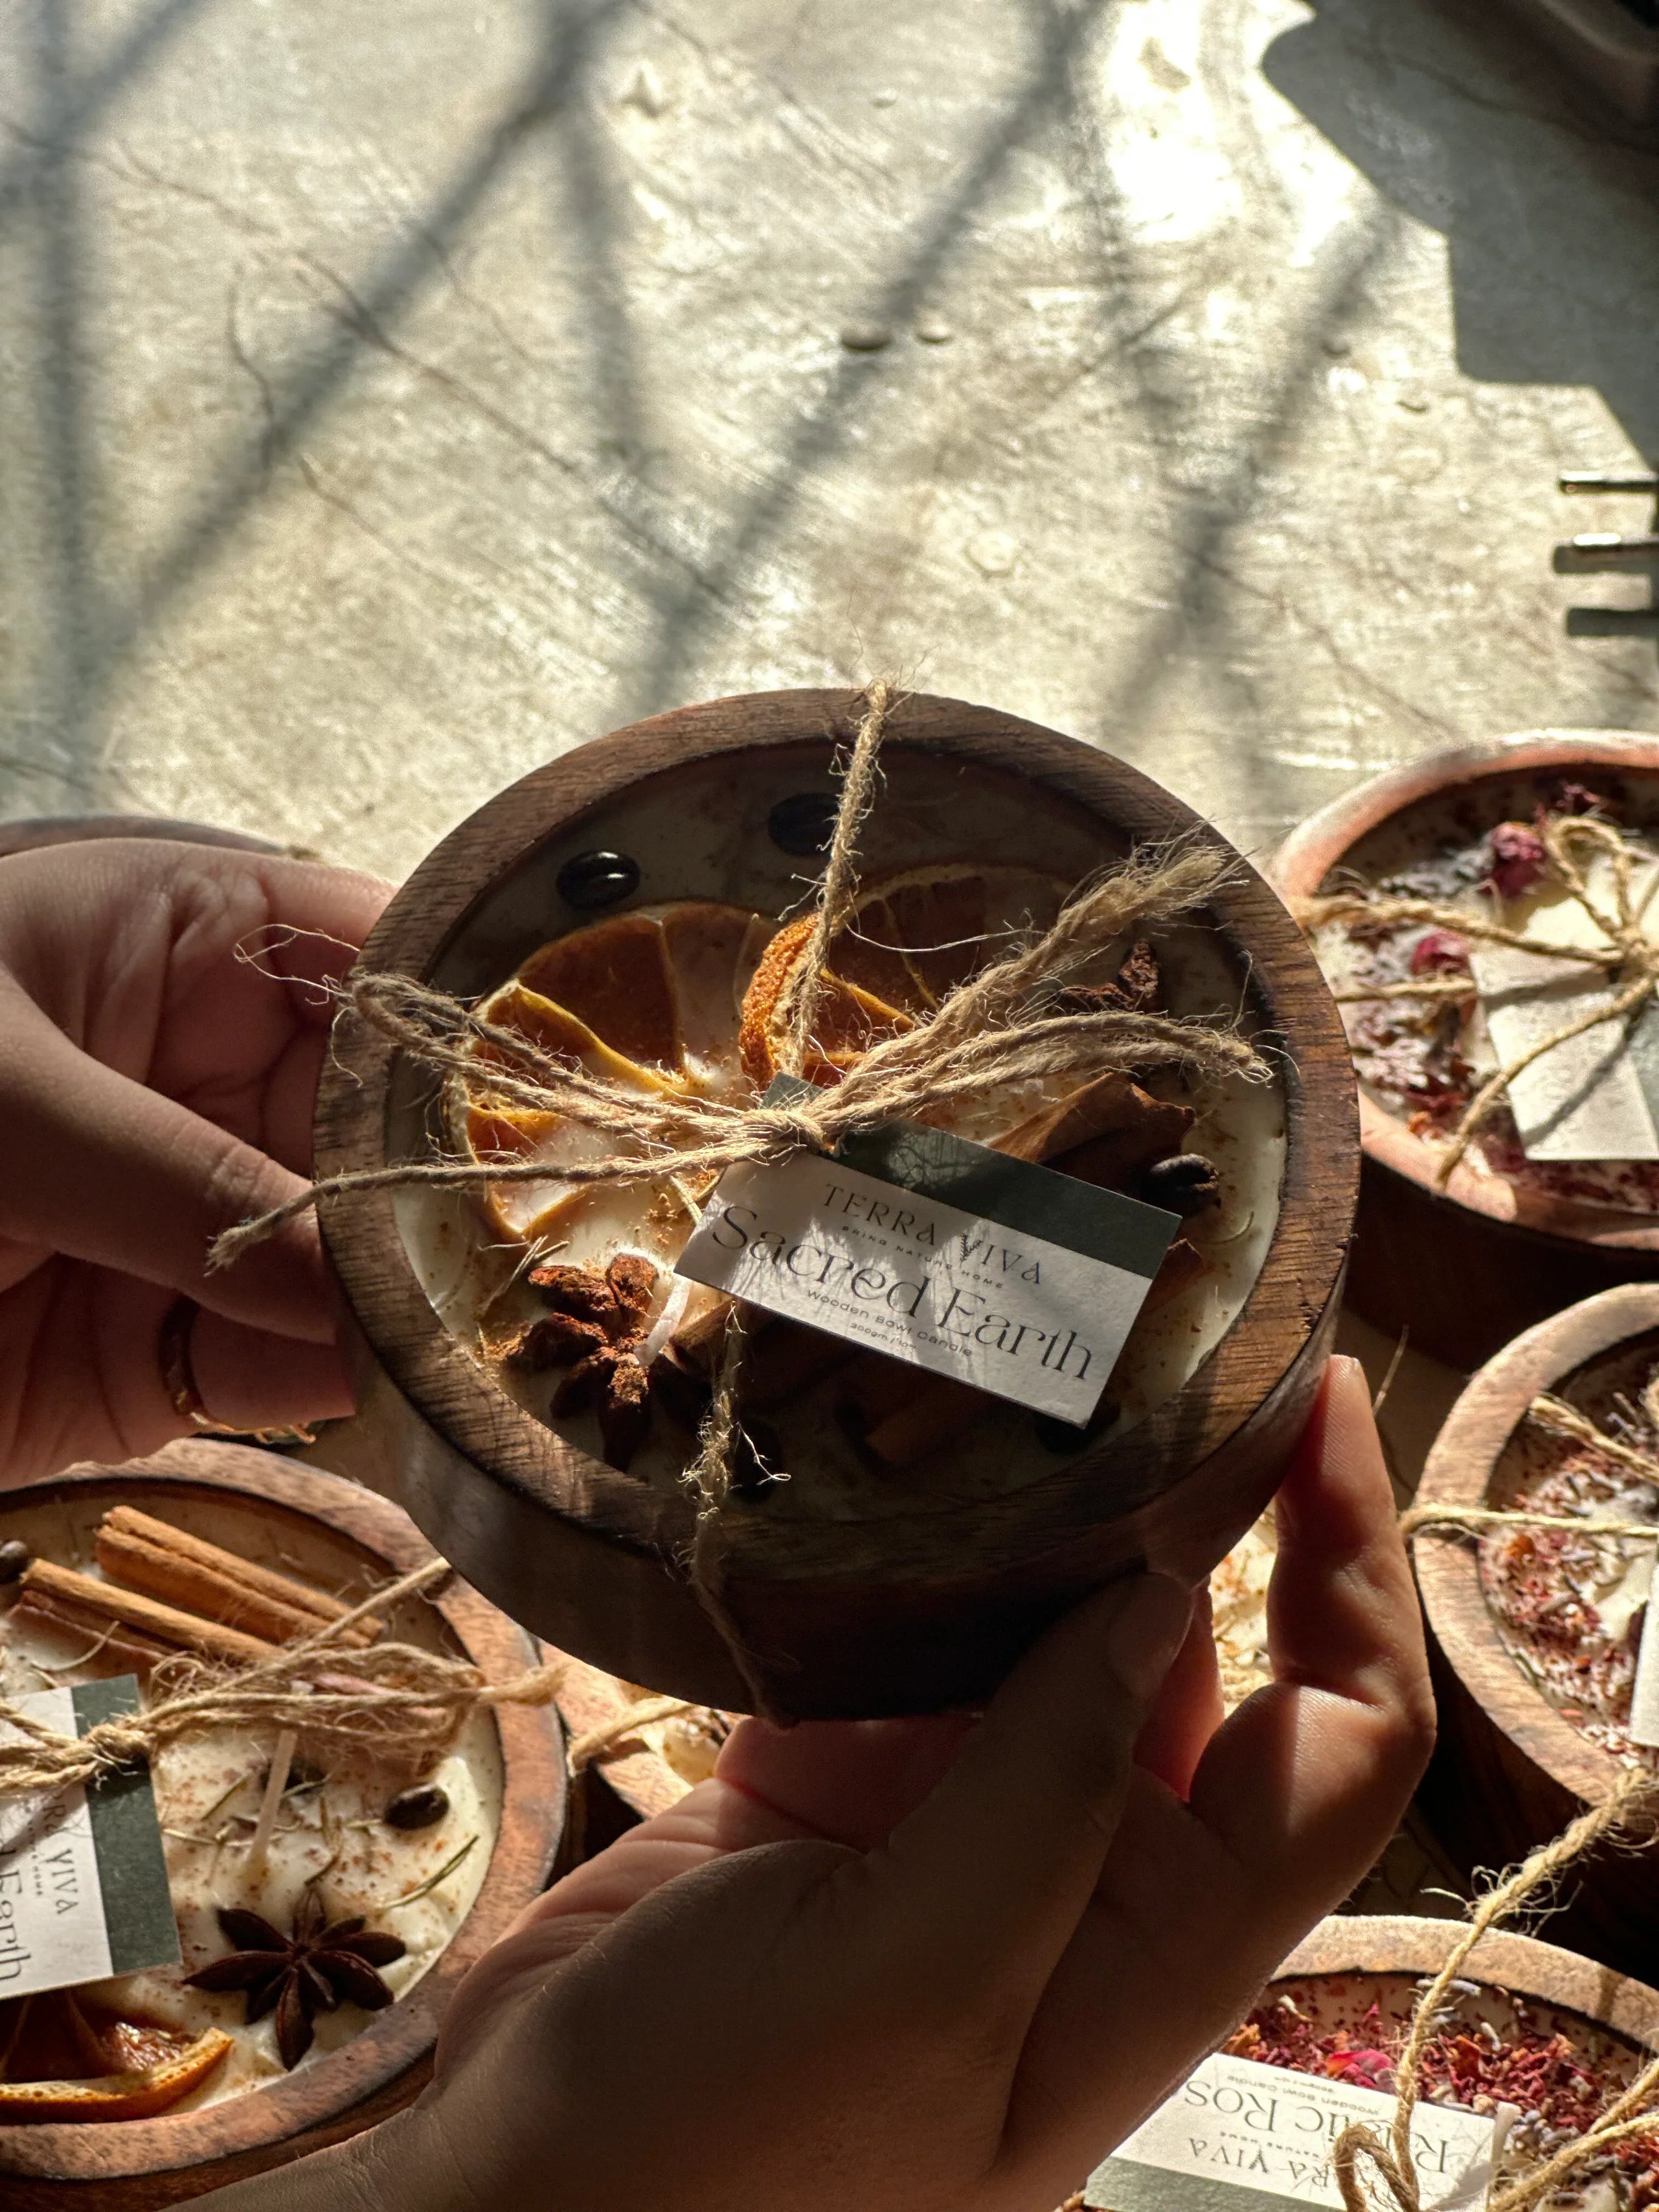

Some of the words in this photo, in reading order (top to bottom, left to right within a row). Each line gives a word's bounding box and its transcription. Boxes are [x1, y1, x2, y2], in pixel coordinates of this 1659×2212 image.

[824, 1184, 935, 1246] TERRA
[960, 1233, 1041, 1285] VIVA
[842, 1226, 888, 1246] BRING
[896, 1246, 952, 1270] NATURE
[962, 1269, 1004, 1289] HOME
[712, 1206, 931, 1317] Sacred
[934, 1287, 1092, 1380] Earth
[808, 1289, 869, 1319] Wooden
[875, 1316, 912, 1335] Bowl
[917, 1331, 972, 1357] Candle
[41, 1847, 78, 1915] VIVA
[1189, 2137, 1269, 2174] VIVA
